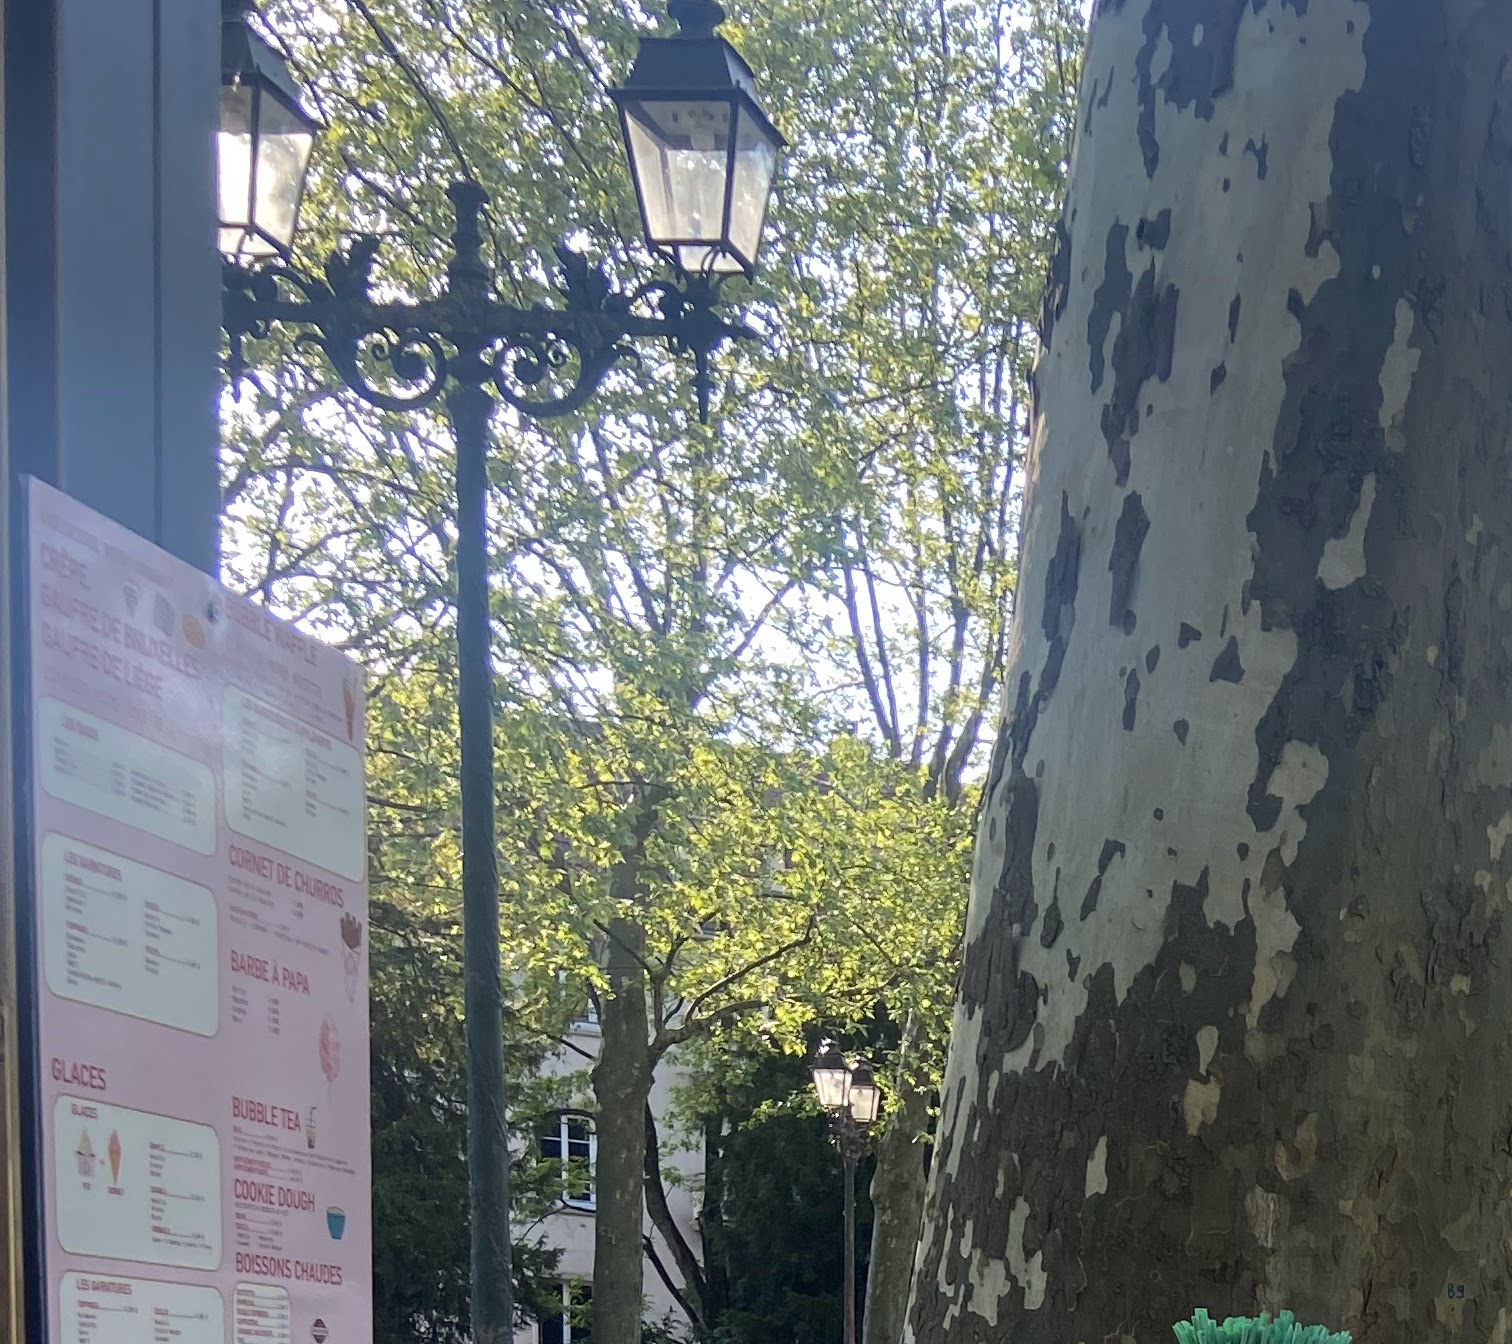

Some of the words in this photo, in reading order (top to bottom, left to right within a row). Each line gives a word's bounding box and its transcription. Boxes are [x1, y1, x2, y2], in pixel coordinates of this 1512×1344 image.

[228, 843, 274, 881] CORNET
[276, 861, 292, 889] DE
[293, 869, 345, 909] CHURROS
[230, 949, 270, 983] BARBE
[282, 966, 311, 996] PAPA
[51, 1057, 107, 1091] GLACES
[231, 1095, 278, 1127] BUBBLE
[280, 1107, 302, 1132] TEA
[234, 1178, 275, 1206] COOKIE
[277, 1184, 315, 1213] DOUGH
[235, 1251, 292, 1280] BOISSONS
[294, 1259, 343, 1286] CHAUDES
